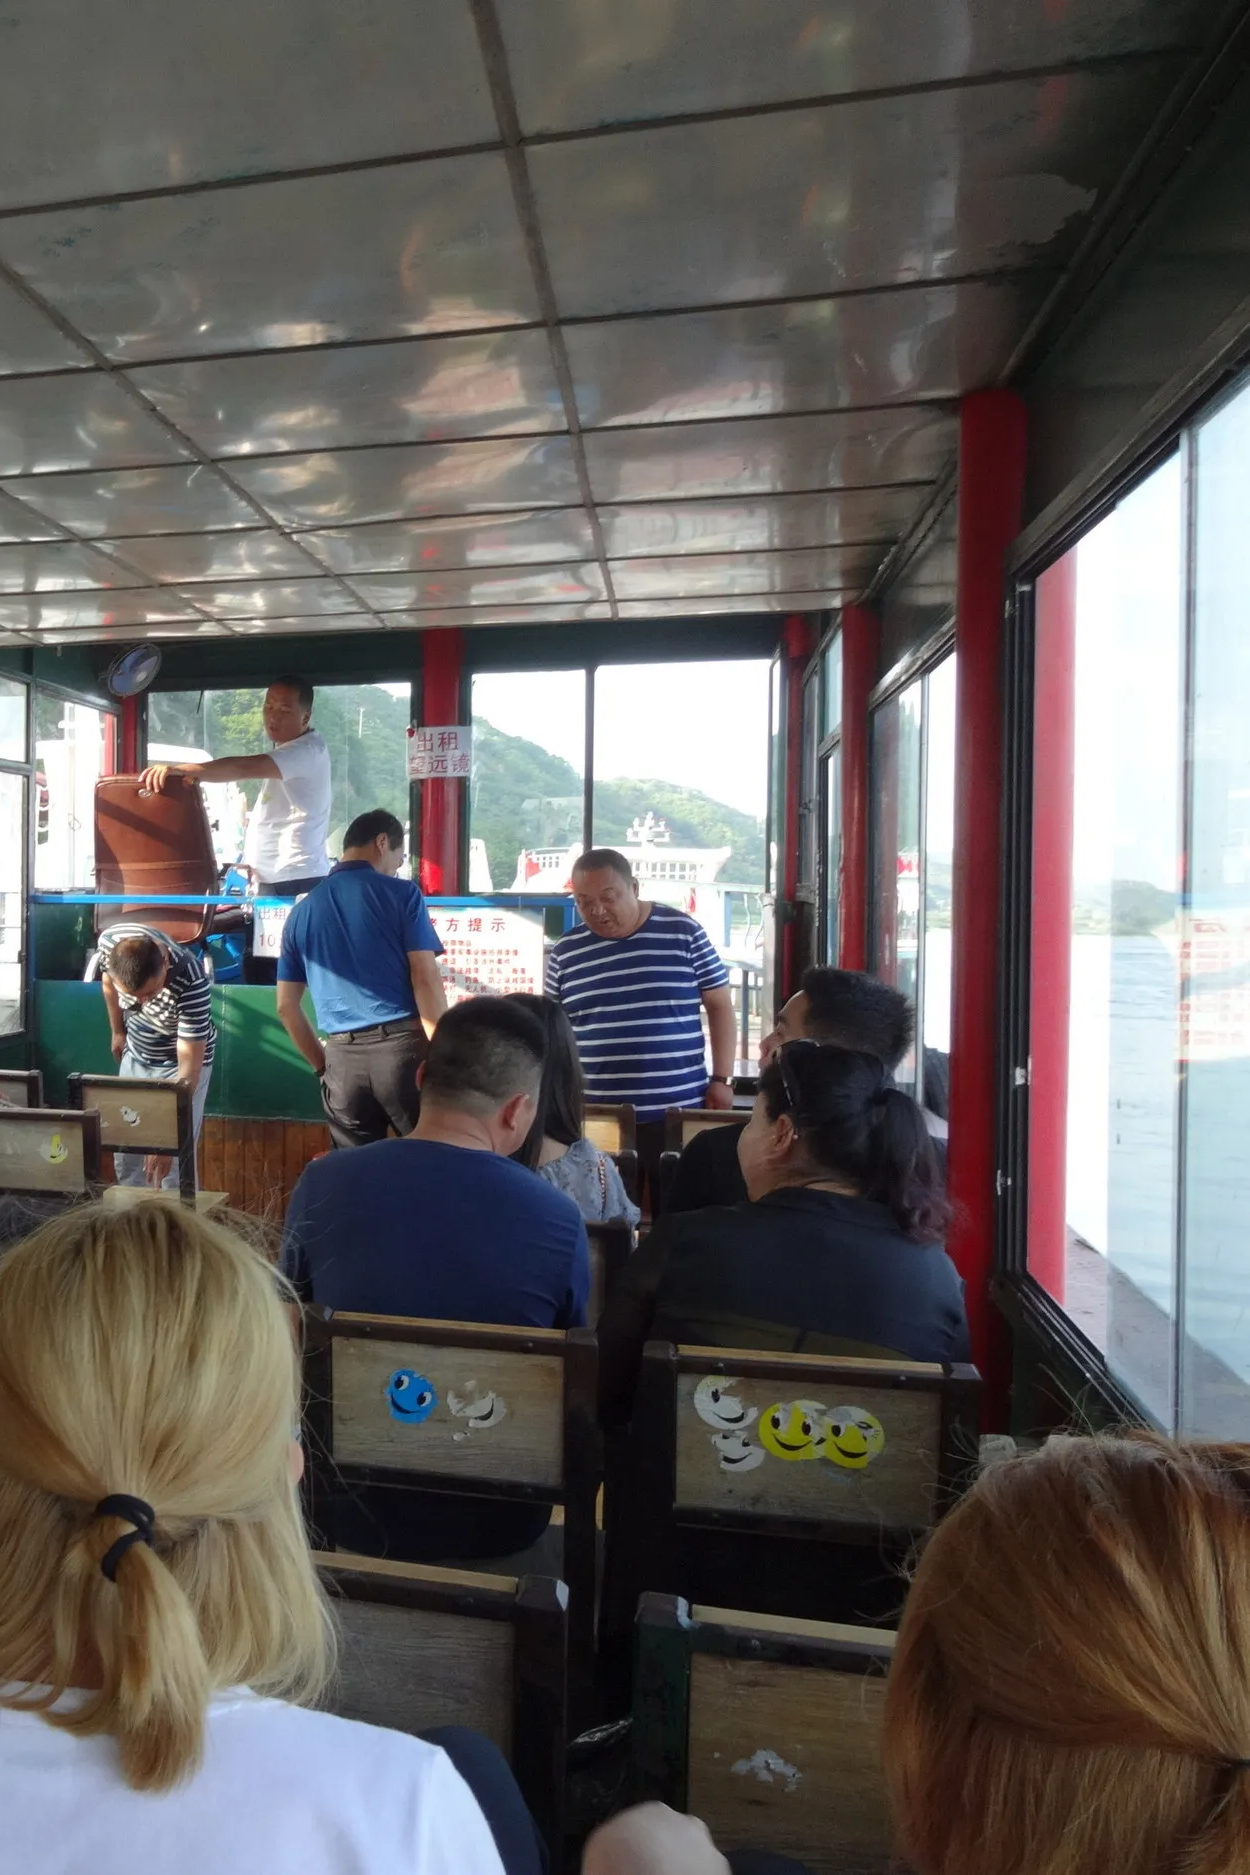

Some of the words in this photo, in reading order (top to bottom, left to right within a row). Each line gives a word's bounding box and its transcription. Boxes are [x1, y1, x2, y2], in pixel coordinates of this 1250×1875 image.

[417, 731, 458, 752] 出租
[409, 753, 470, 774] 望远镜
